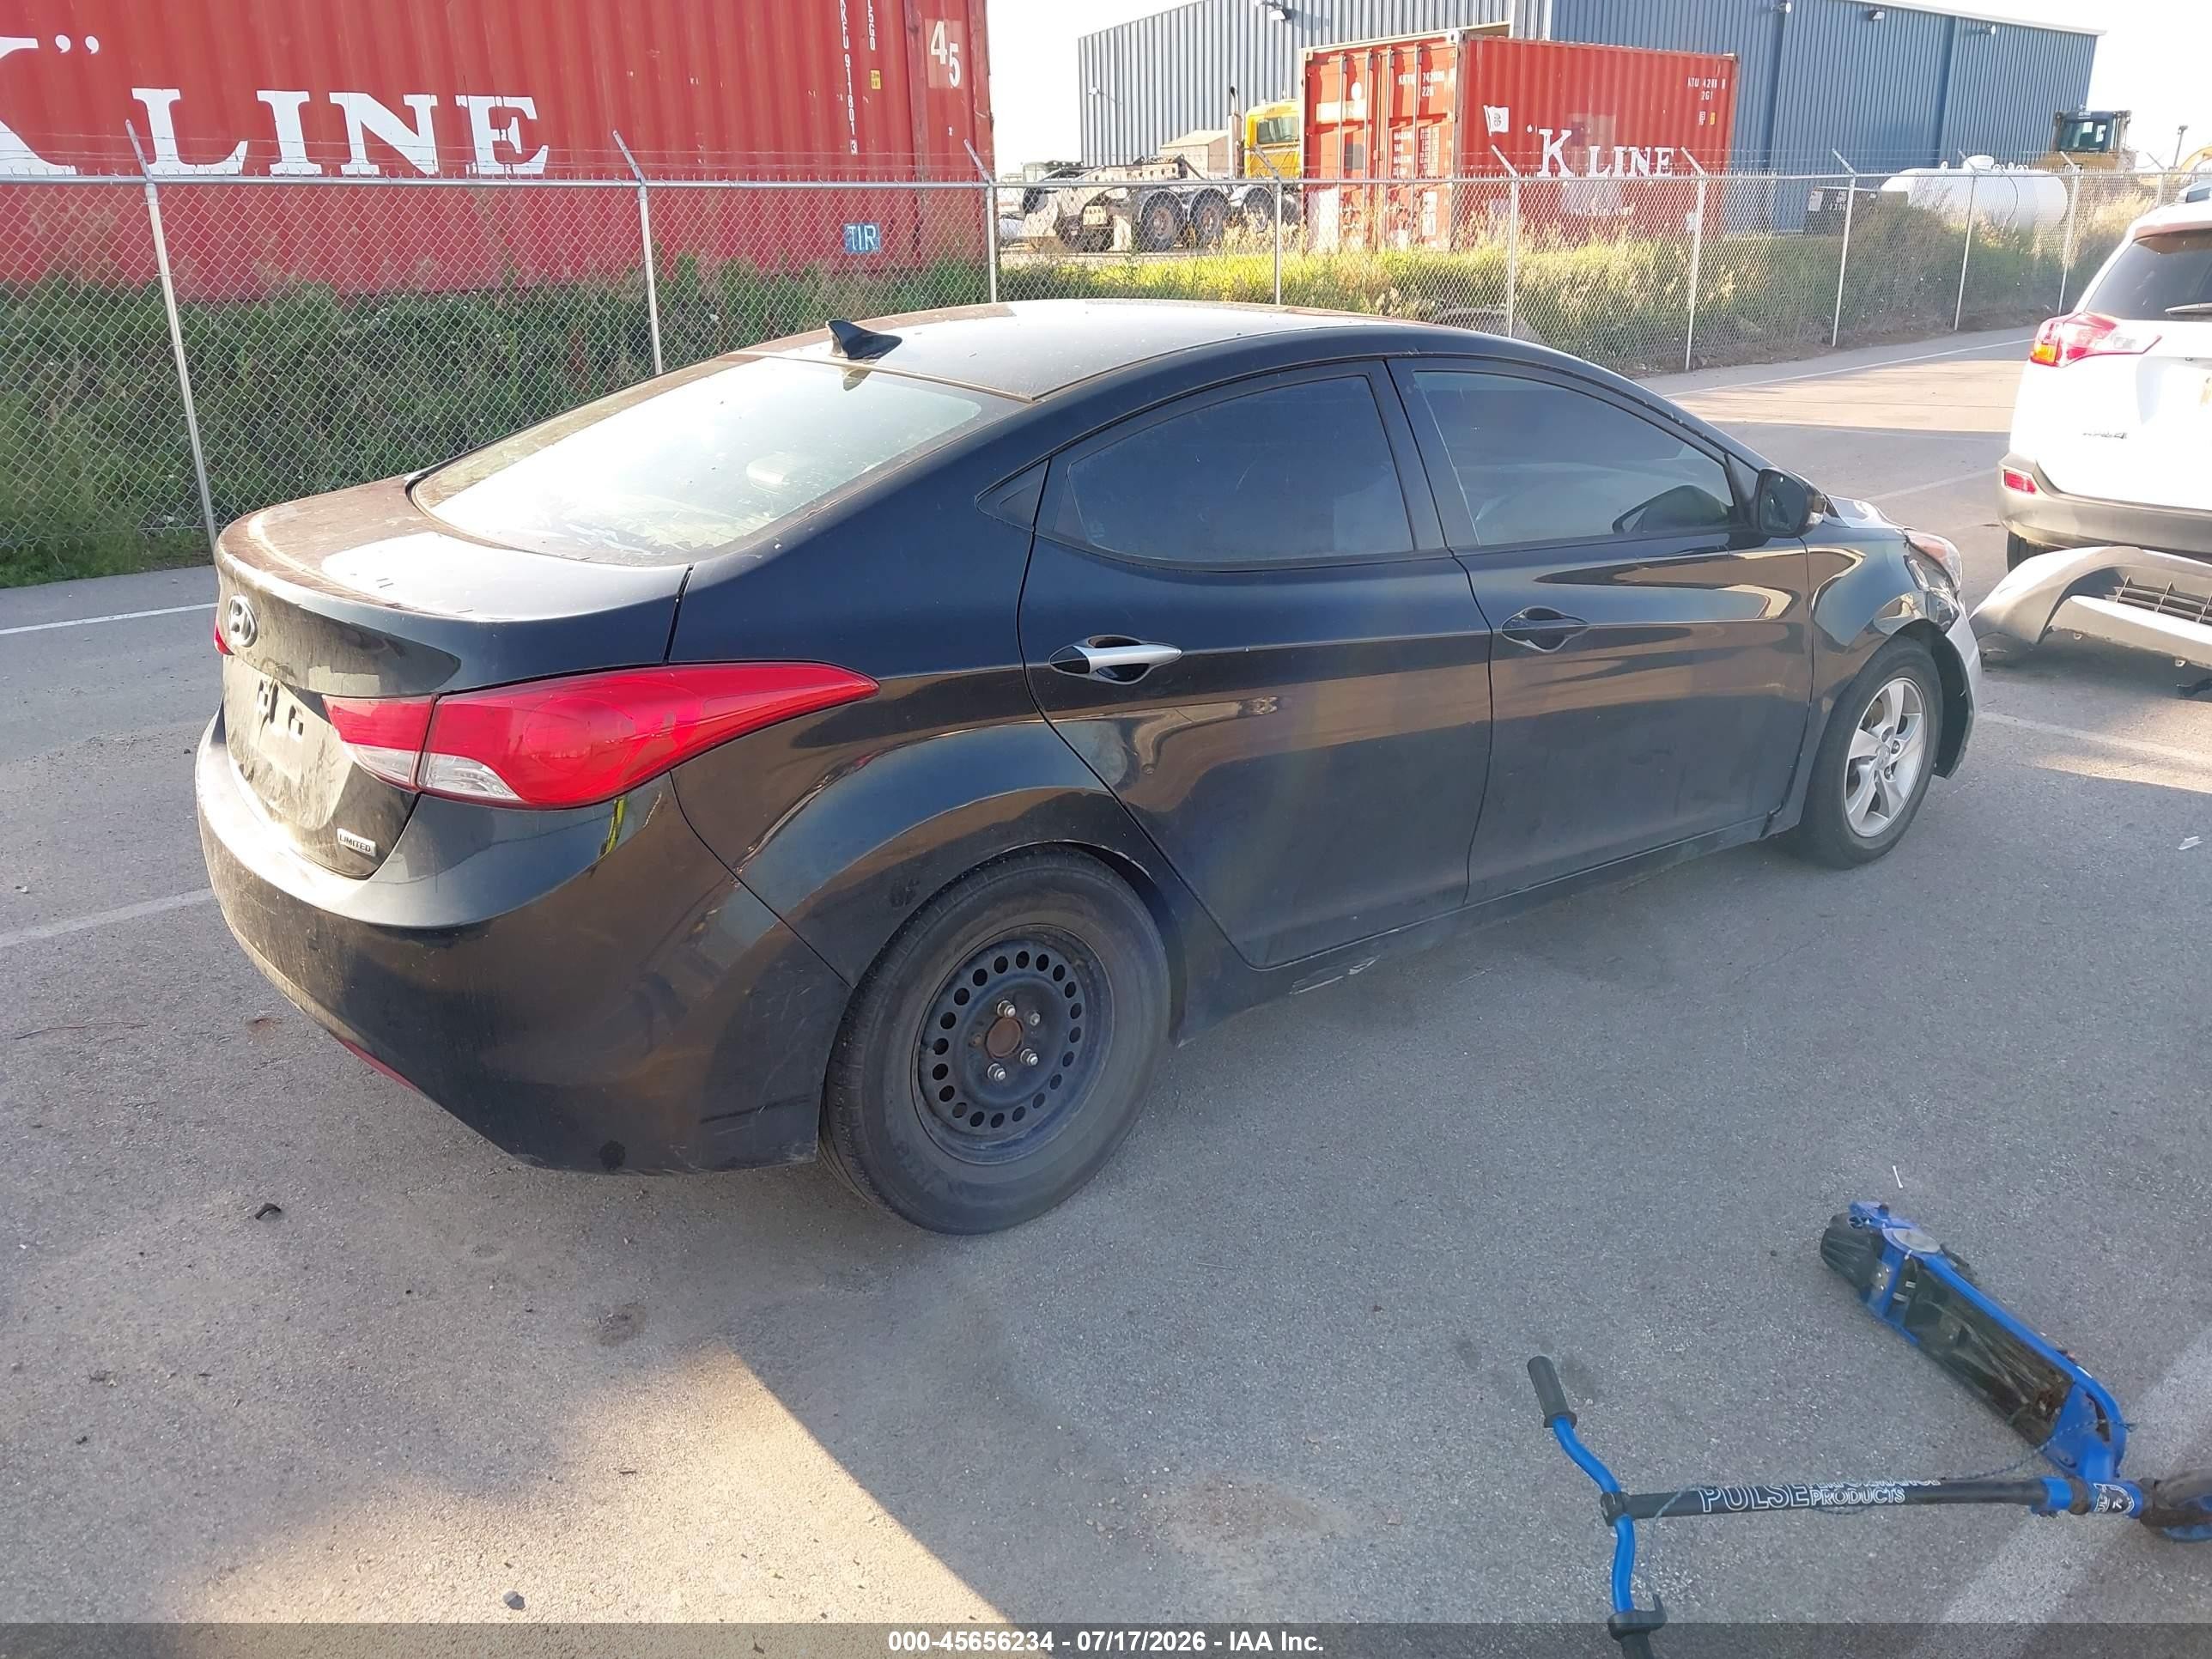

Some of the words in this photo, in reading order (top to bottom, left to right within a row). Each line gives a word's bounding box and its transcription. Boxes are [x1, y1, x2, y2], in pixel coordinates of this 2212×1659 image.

[930, 21, 962, 88] 45
[131, 88, 549, 177] LINE
[1587, 145, 1674, 177] LINE
[847, 224, 877, 251] TIR
[339, 833, 371, 853] LIMITED
[1698, 1484, 1809, 1512] PULSE
[1809, 1486, 1905, 1505] PRODUCTS
